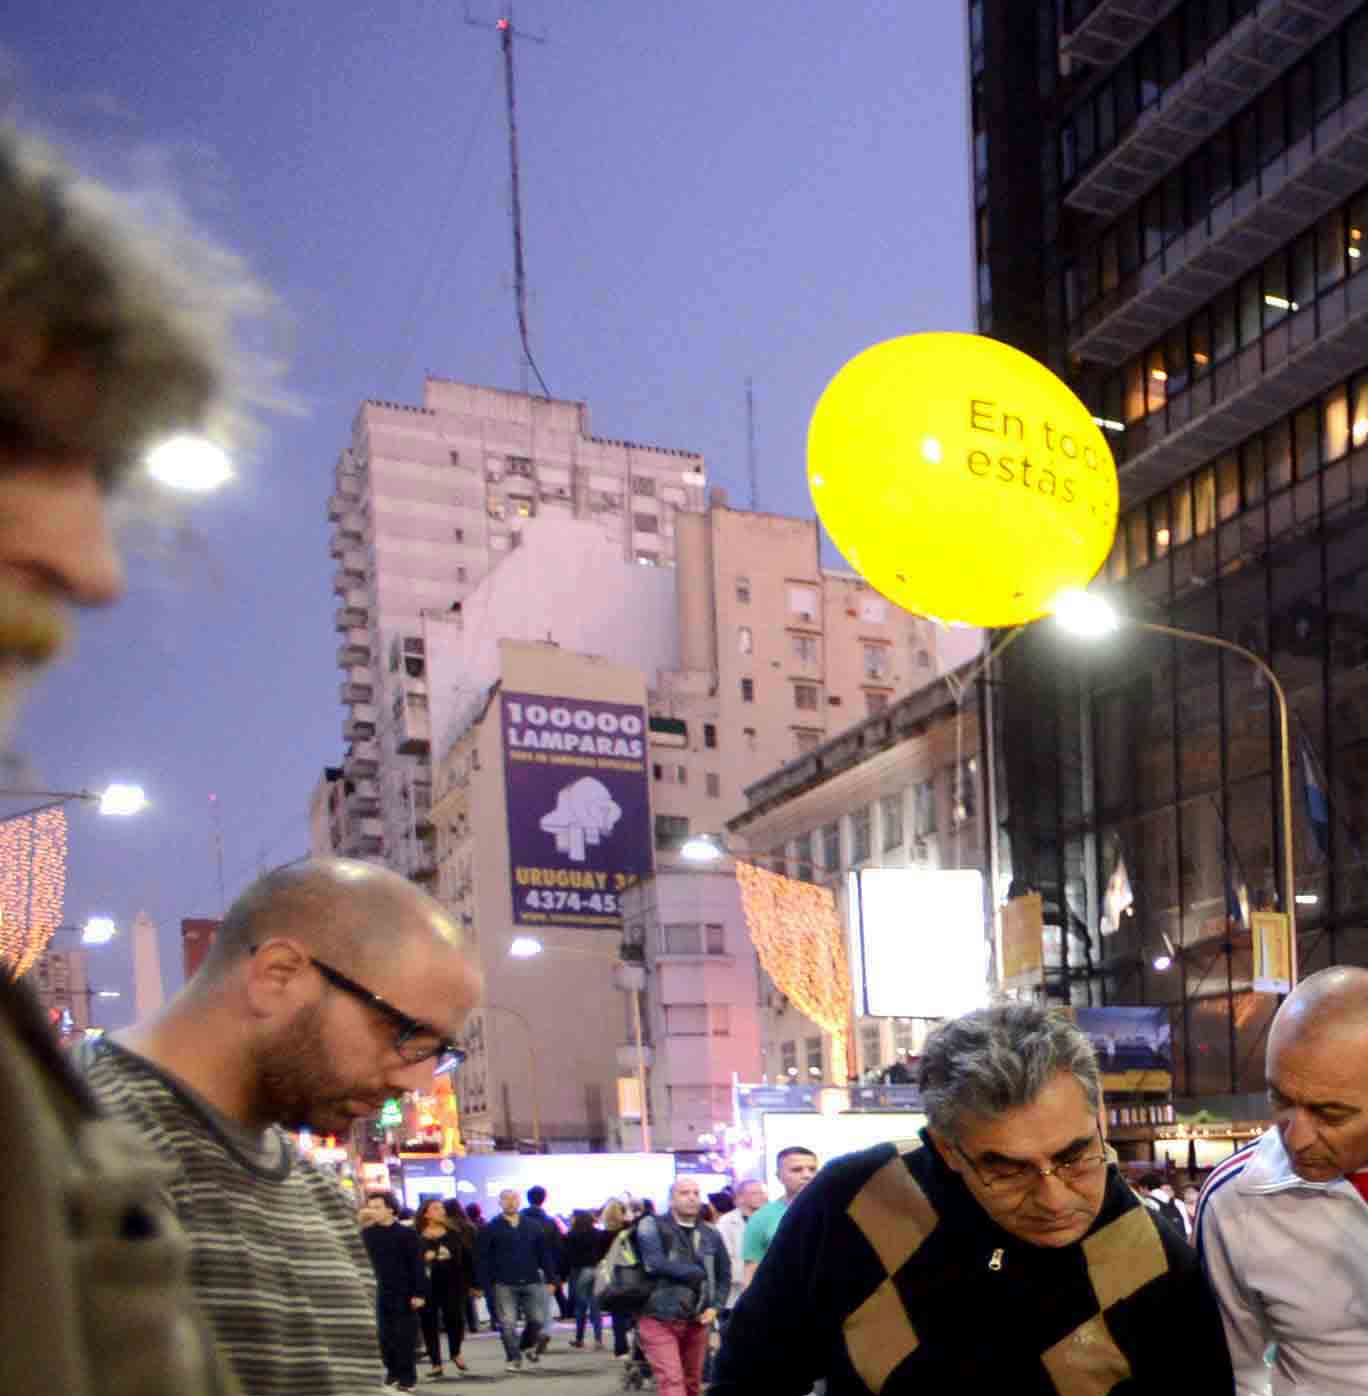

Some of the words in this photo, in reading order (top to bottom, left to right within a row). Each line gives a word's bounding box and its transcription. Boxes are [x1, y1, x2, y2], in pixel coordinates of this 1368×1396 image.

[970, 399, 1024, 441] En
[507, 703, 642, 735] 100000
[508, 728, 643, 758] LAMPARAS
[515, 867, 609, 890] URUGUAY
